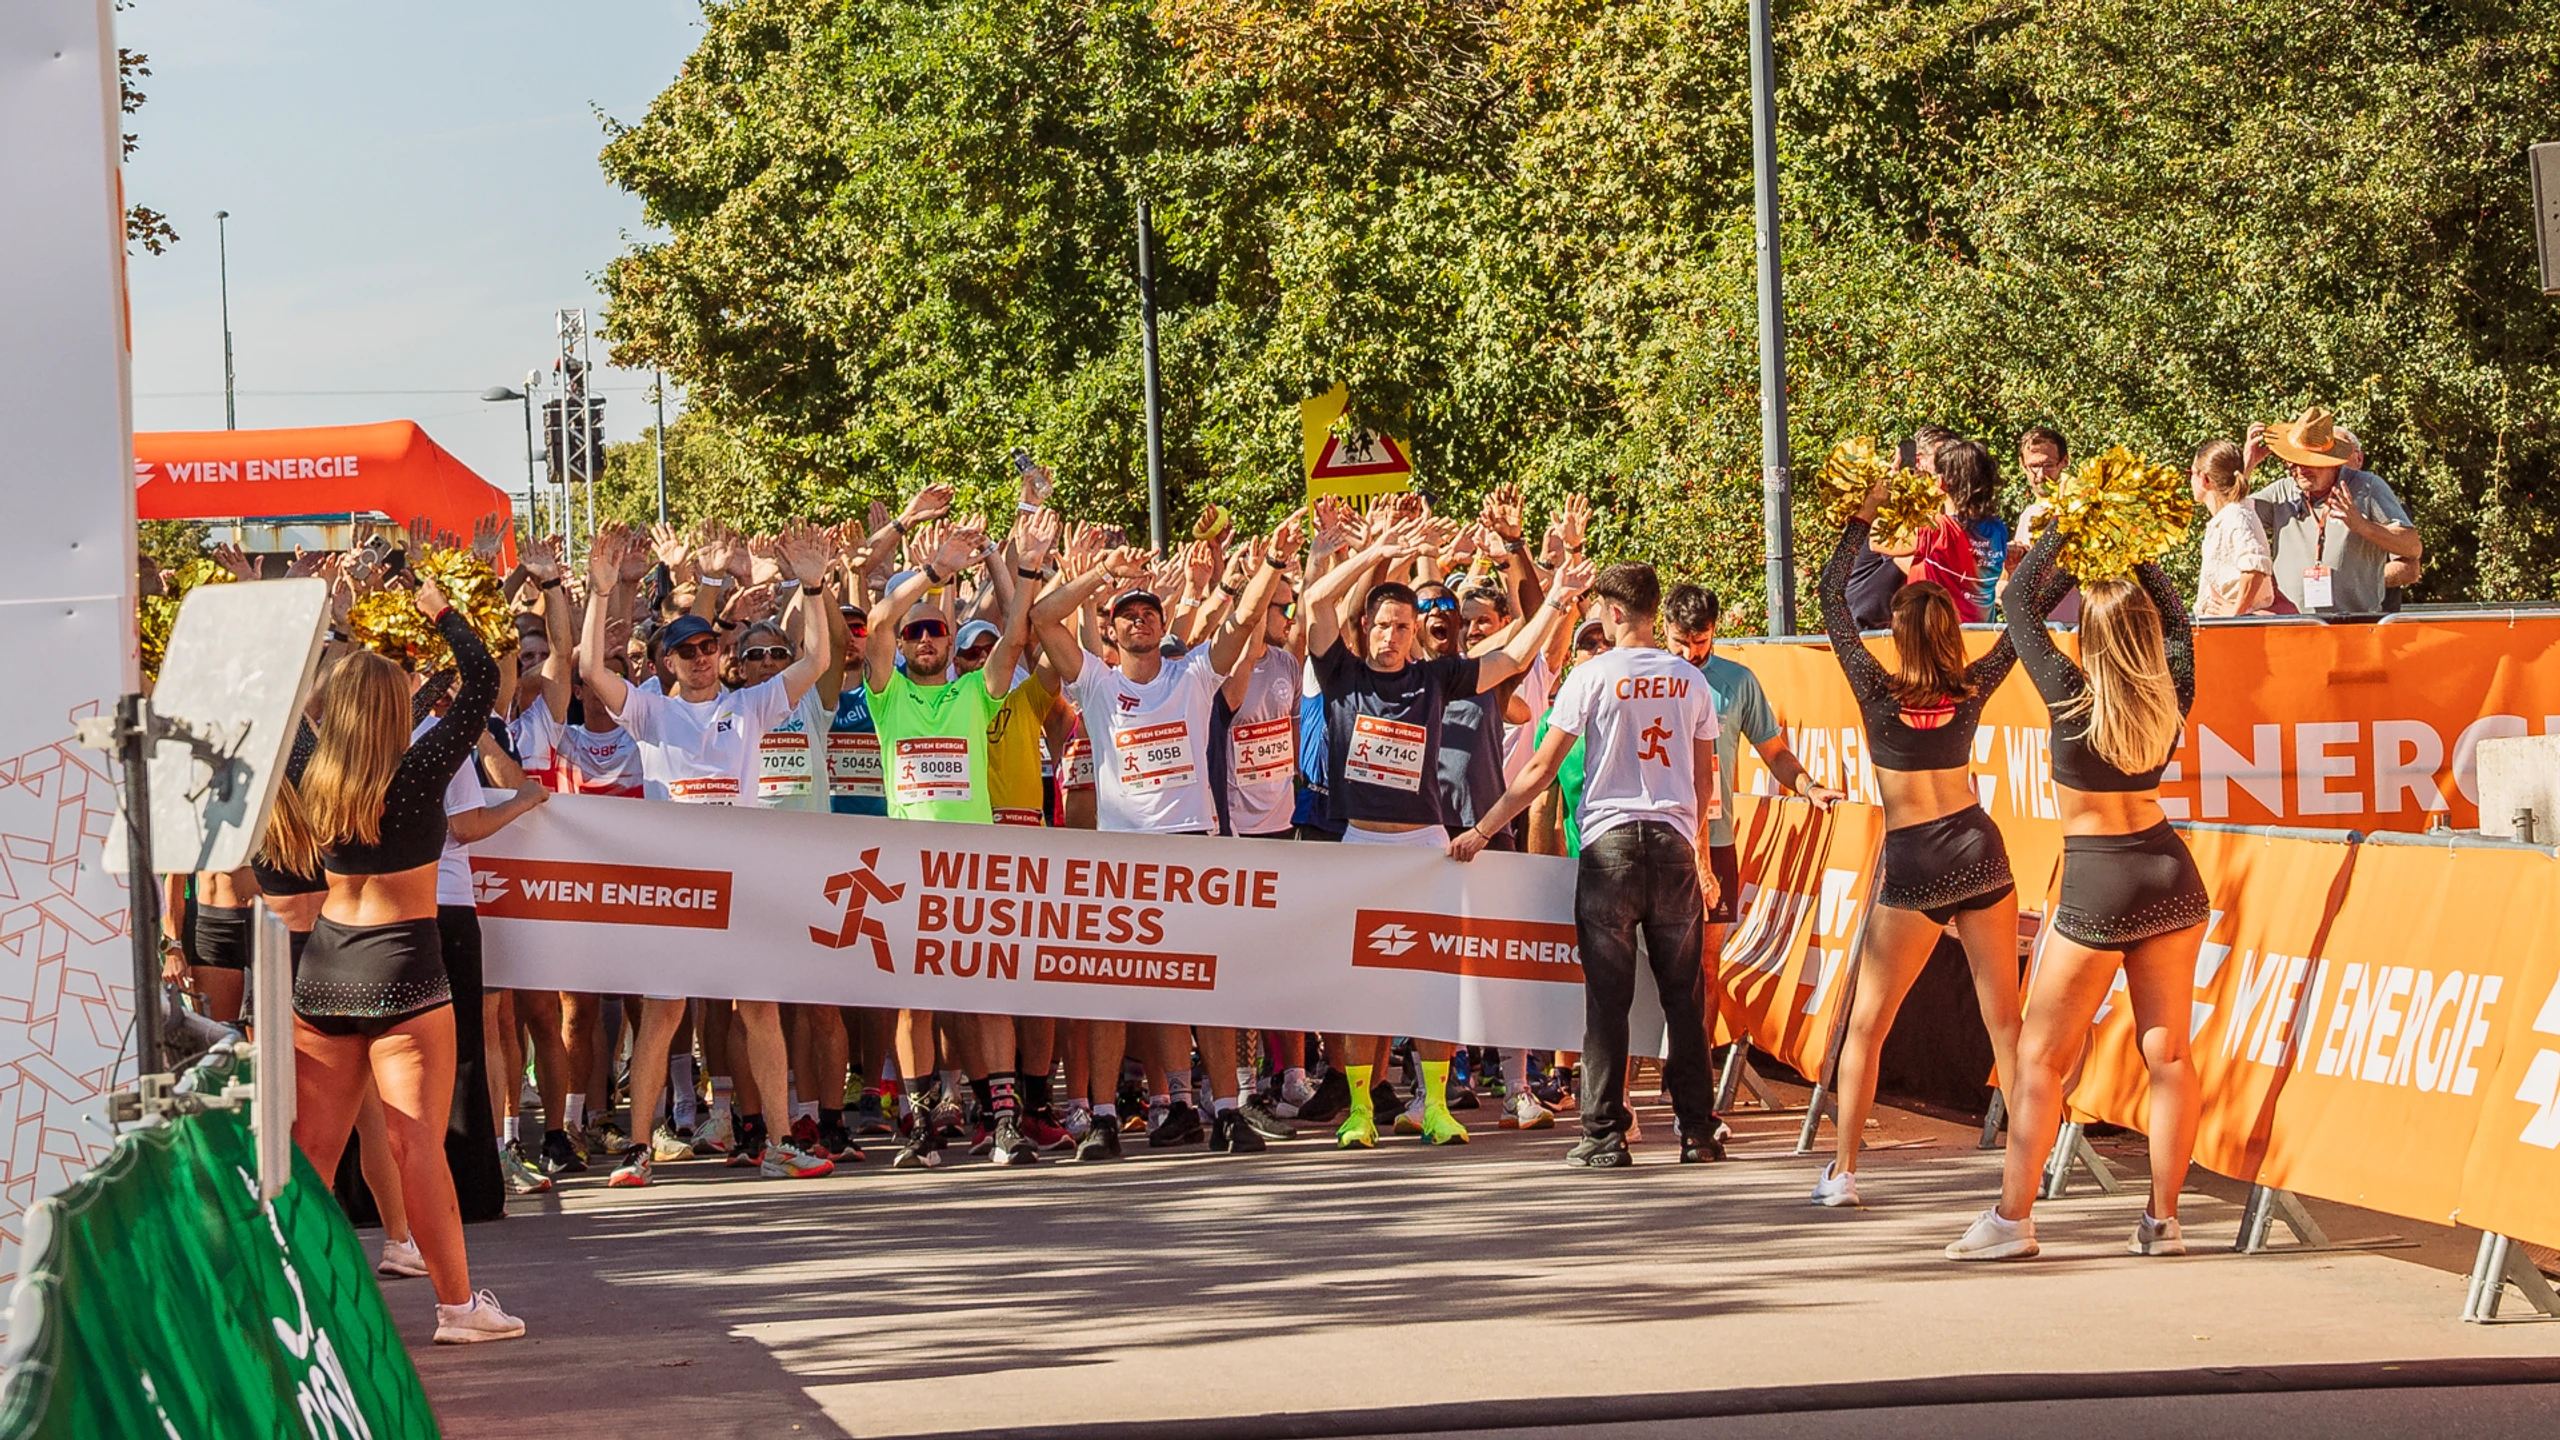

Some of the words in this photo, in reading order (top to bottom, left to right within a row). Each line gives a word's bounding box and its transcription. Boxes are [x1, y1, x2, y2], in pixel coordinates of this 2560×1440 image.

[165, 460, 239, 484] WIEN
[246, 456, 359, 482] ENERGIE
[1615, 677, 1690, 701] CREW
[717, 719, 732, 733] EY
[1375, 724, 1394, 733] WIEN
[857, 739, 880, 747] ENERG
[1133, 731, 1153, 740] WIEN
[1147, 746, 1182, 762] 505B
[1257, 740, 1289, 757] 9479C
[1375, 744, 1418, 762] 4714C
[763, 756, 805, 768] 7074C
[842, 757, 883, 769] 5045A
[921, 761, 963, 773] 8008B
[1081, 762, 1094, 775] 37
[2157, 714, 2560, 819] NER
[2003, 726, 2061, 820] WIE
[920, 849, 1049, 894] WIEN
[1063, 858, 1278, 909] ENERGIE
[520, 878, 594, 903] WIEN
[601, 883, 717, 910] ENERGIE
[917, 894, 1164, 946] BUSINESS
[1428, 932, 1498, 959] WIEN
[1505, 939, 1583, 964] ENER
[913, 938, 1020, 980] RUN
[1039, 954, 1211, 982] DONAUINSEL
[2221, 949, 2330, 1074] WIEN
[2315, 962, 2503, 1096] ENERGIE
